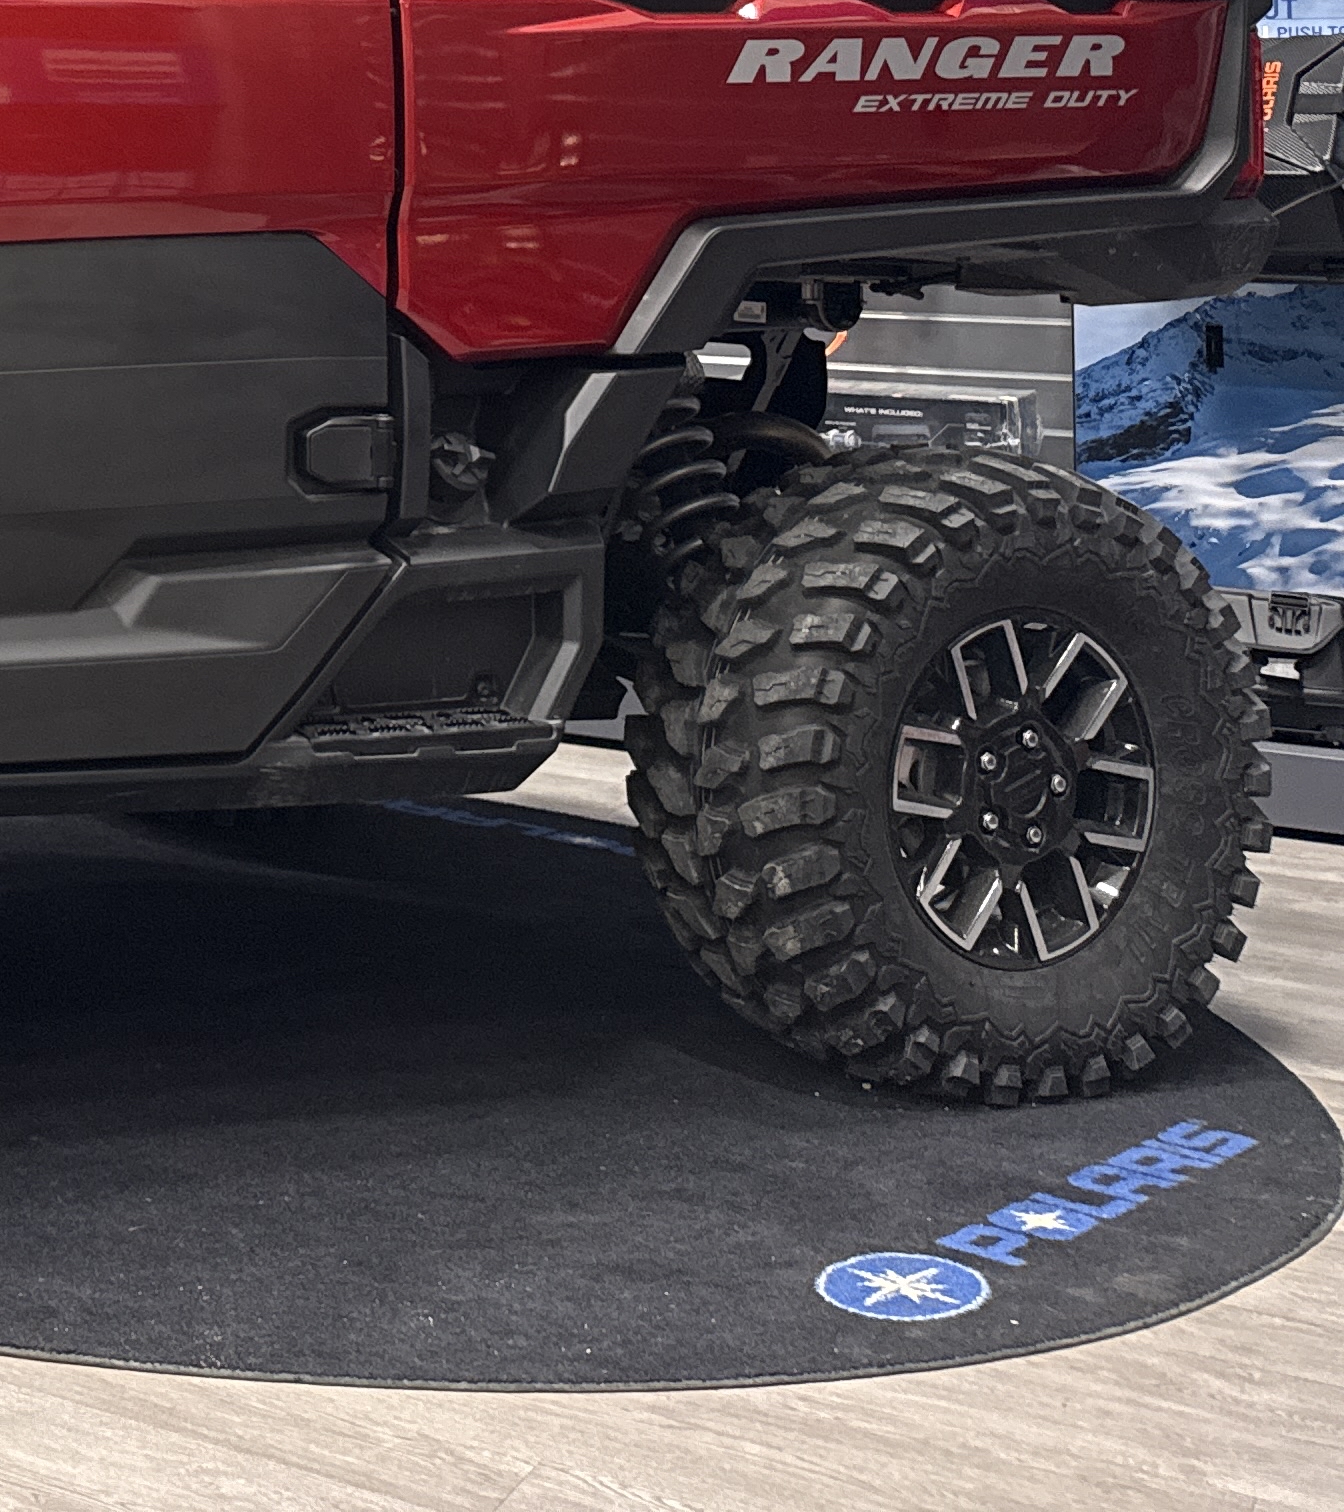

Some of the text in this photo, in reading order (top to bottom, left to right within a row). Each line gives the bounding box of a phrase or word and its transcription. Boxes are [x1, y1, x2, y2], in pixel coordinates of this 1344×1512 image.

[726, 35, 1125, 84] RANGER
[853, 89, 1139, 113] EXTREME DUTY
[935, 1119, 1259, 1266] POLARIS
